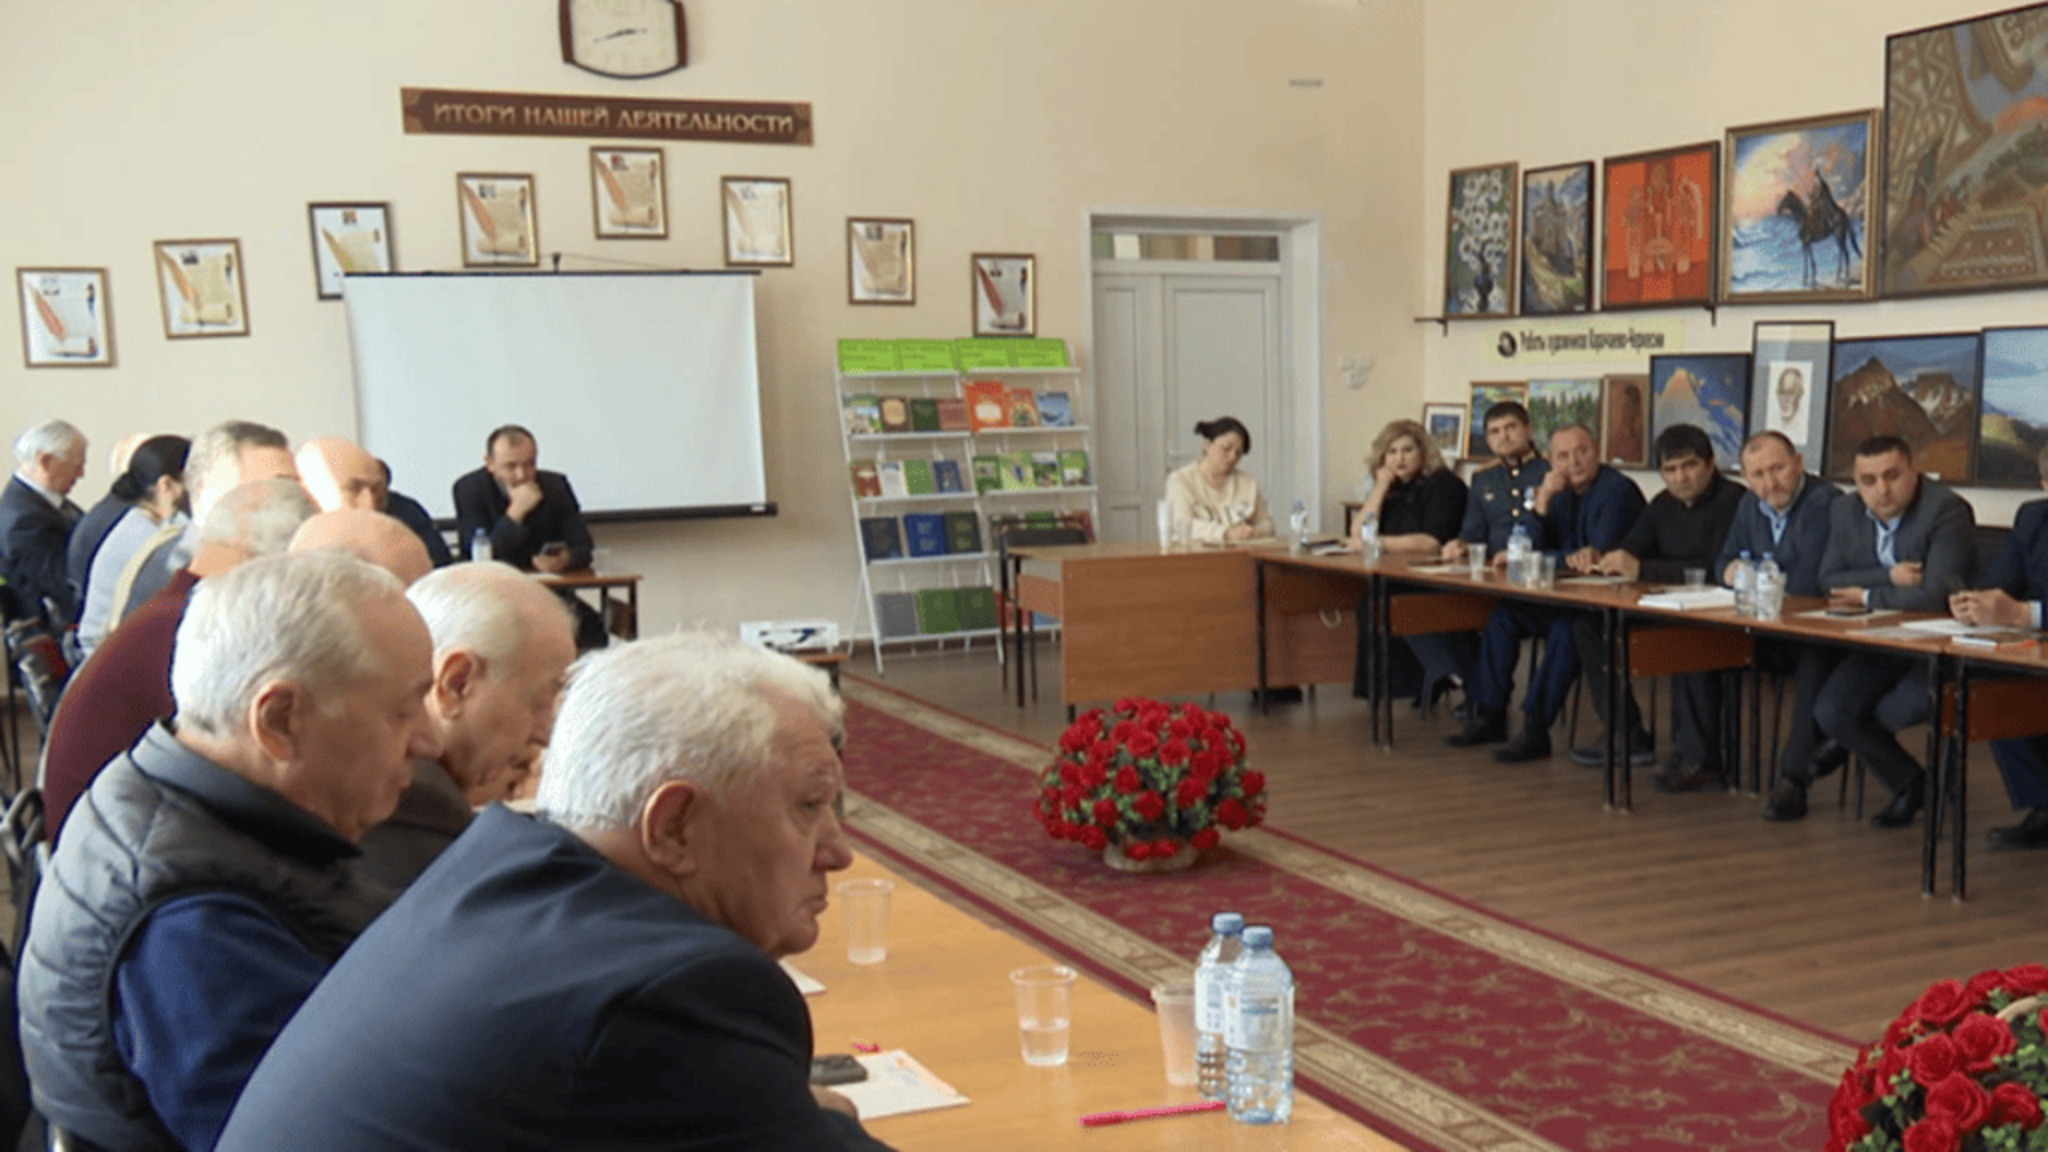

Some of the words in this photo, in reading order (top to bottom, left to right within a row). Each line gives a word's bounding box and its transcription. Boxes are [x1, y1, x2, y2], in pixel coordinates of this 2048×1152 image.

[433, 103, 516, 125] ИТОГИ
[523, 105, 609, 127] НАШЕЙ
[616, 109, 793, 133] ДЕЯТЕЛЬНОСТИ
